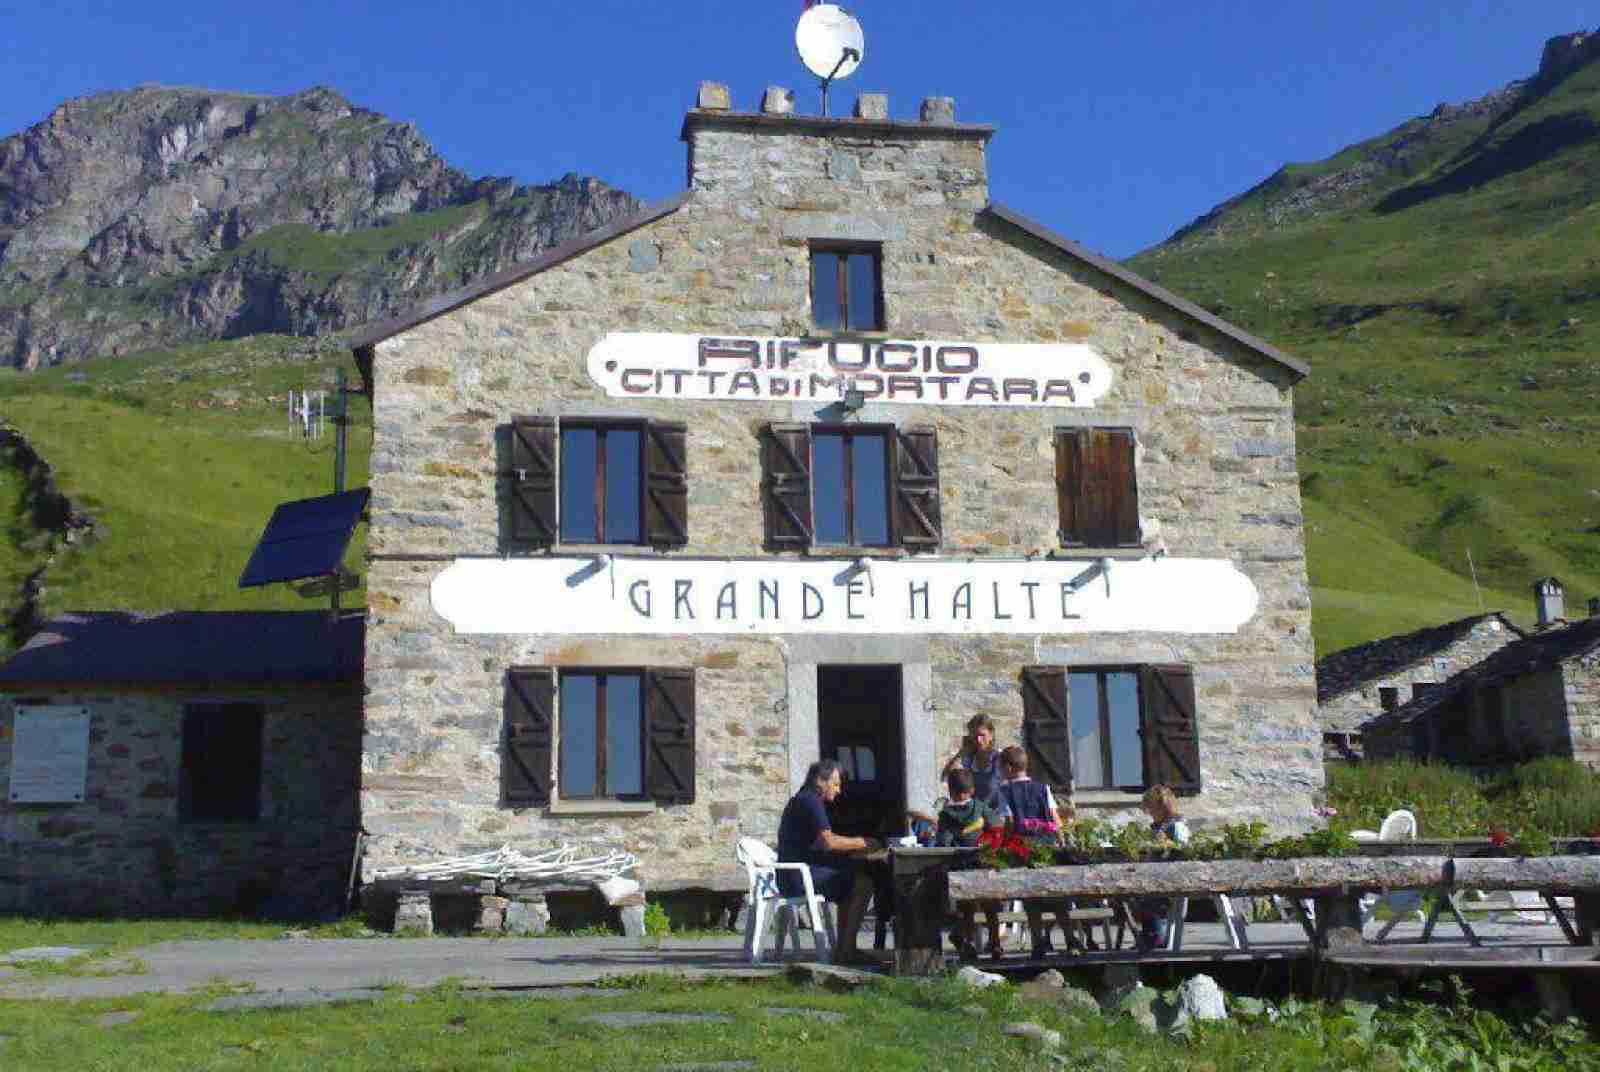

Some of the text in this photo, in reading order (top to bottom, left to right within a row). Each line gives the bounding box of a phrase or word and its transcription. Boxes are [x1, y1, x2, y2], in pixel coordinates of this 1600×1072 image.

[697, 337, 979, 373] RIFUGIO
[808, 373, 1076, 402] MORTARA
[628, 579, 1082, 620] GRANDE HALTE
